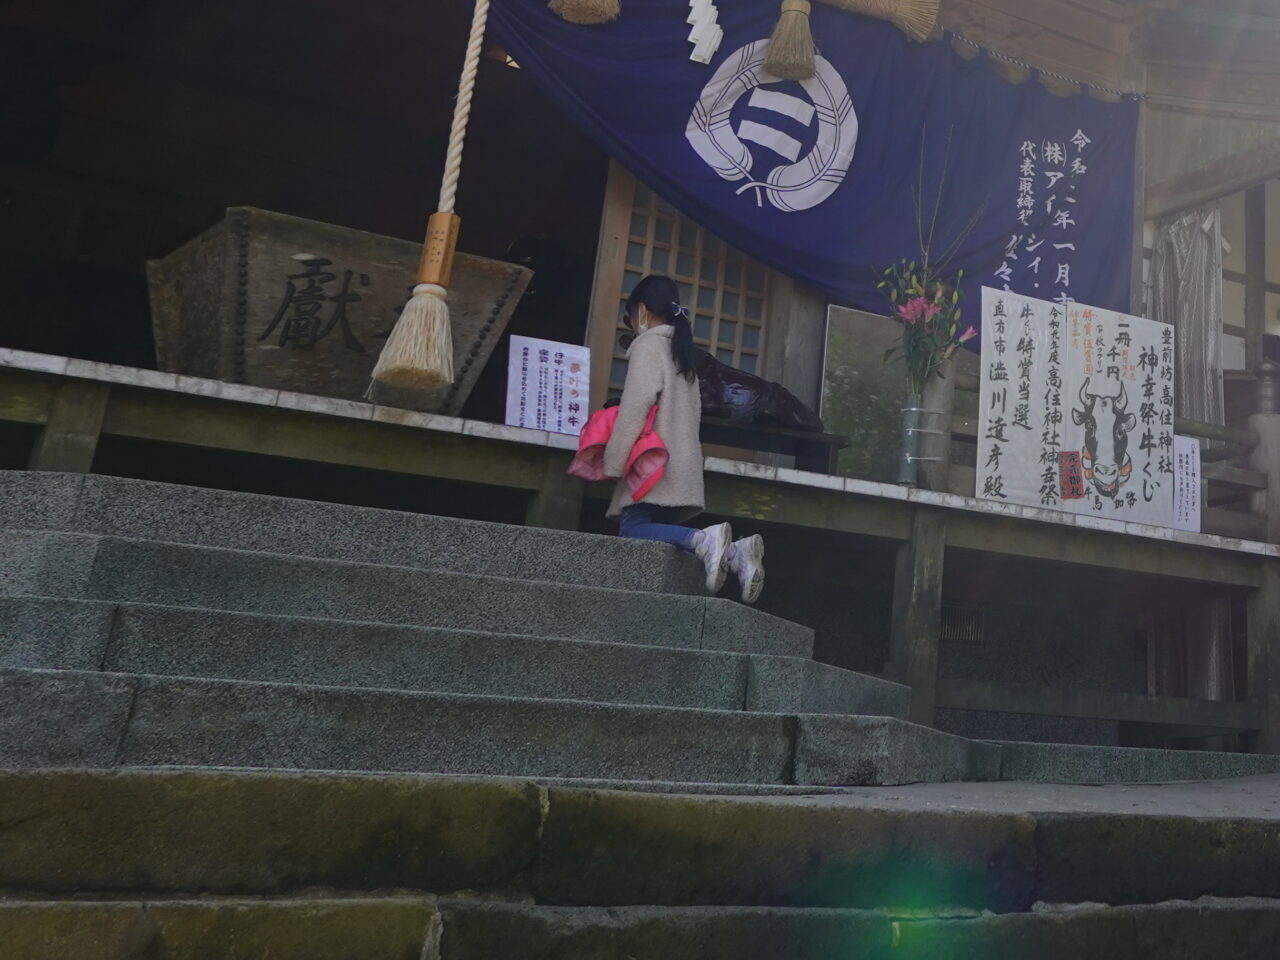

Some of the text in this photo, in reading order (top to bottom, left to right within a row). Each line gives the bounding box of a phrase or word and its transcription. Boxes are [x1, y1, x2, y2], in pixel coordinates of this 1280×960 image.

[1011, 303, 1036, 431] 牛くじ特賞当選
[1106, 345, 1121, 382] 千円
[1136, 344, 1160, 504] 神幸祭牛くじ
[1157, 327, 1175, 474] 豊前坊高住神社
